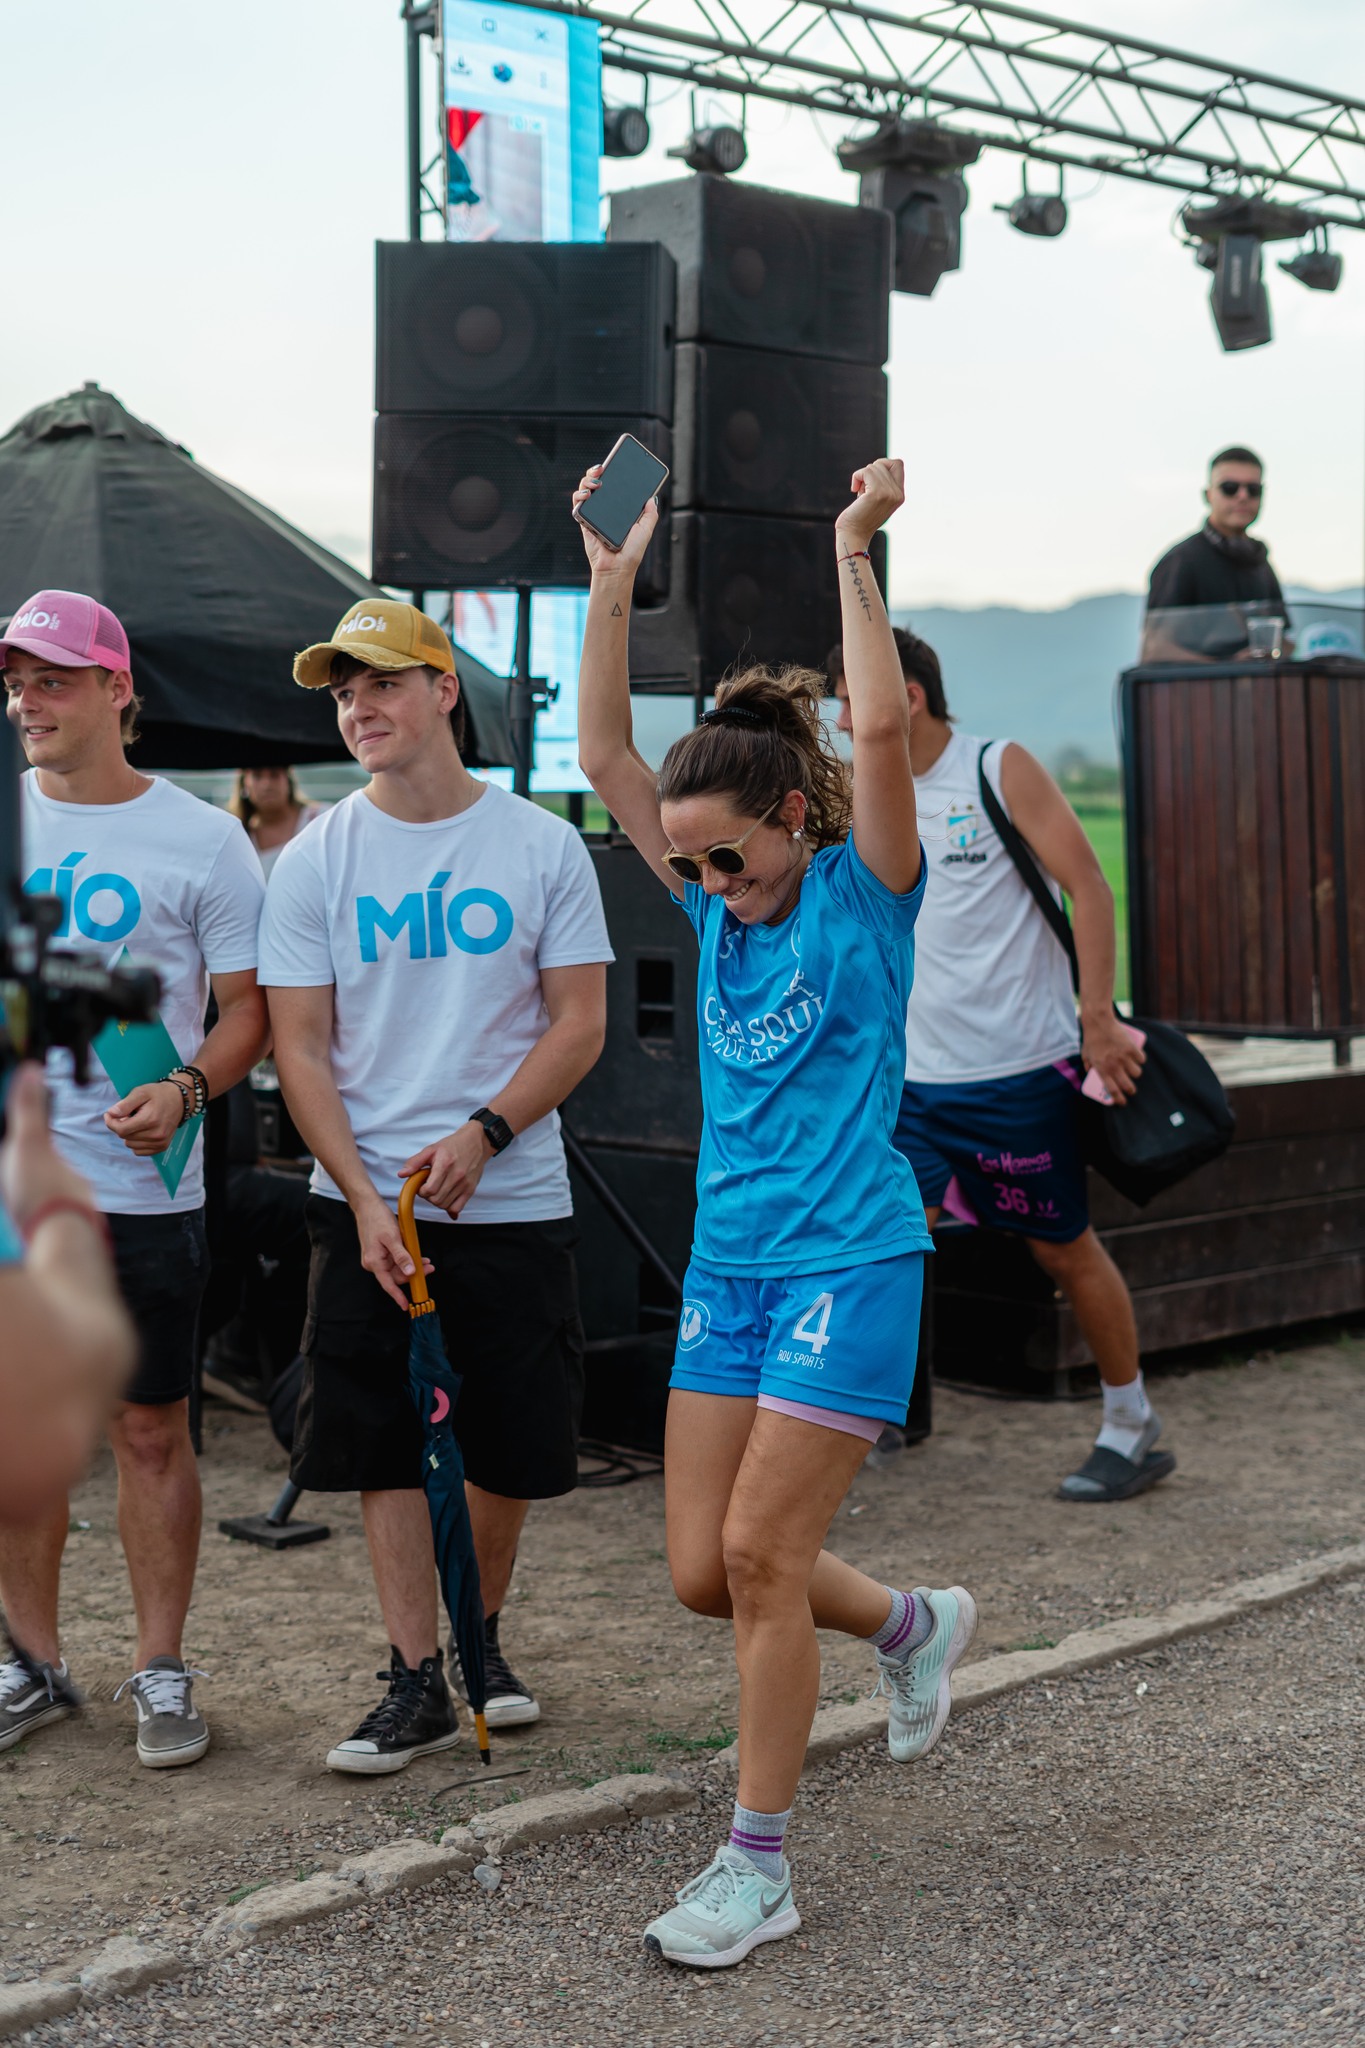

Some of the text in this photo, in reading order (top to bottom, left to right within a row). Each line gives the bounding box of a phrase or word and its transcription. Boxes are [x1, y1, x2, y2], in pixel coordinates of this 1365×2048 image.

[22, 851, 141, 942] ÍO
[356, 871, 514, 962] MÍO
[993, 1182, 1029, 1215] 36
[792, 1292, 833, 1354] 4
[791, 1352, 826, 1370] SPORTS
